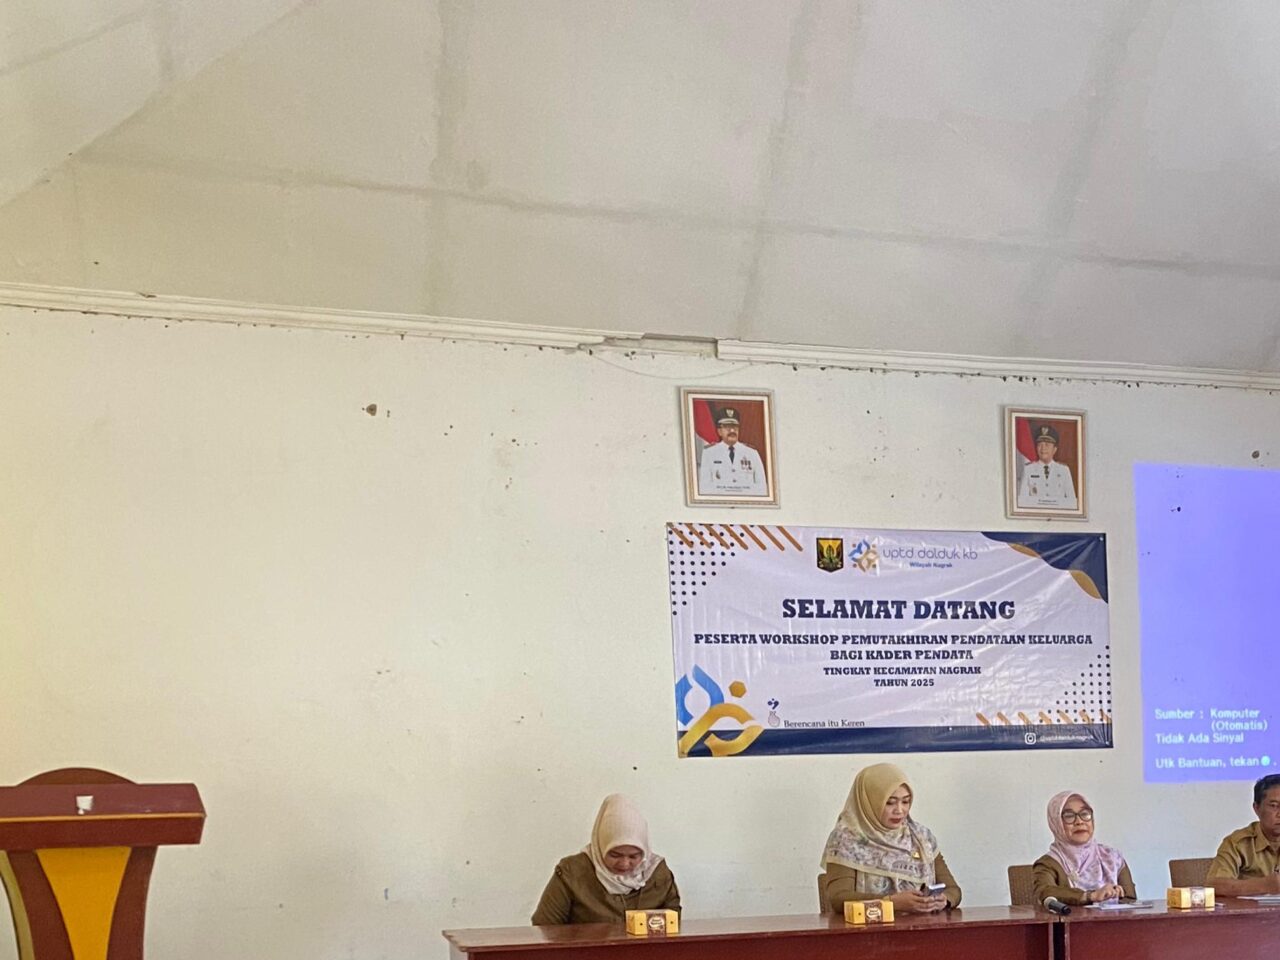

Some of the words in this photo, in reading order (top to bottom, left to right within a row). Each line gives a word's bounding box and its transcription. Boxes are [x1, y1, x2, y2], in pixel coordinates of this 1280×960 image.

[883, 547, 914, 559] uptd
[963, 550, 978, 560] kb
[782, 599, 907, 619] SELAMAT
[913, 600, 1015, 620] DATANG
[694, 633, 758, 644] PESERTA
[759, 634, 839, 645] WORKSHOP
[842, 634, 948, 645] PEMUTAKHIRAN
[951, 634, 1026, 645] PENDATAAN
[1028, 634, 1093, 645] KELUARGA
[830, 650, 863, 660] BAGI
[865, 650, 912, 660] KADER
[915, 650, 974, 660] PENDATA
[823, 667, 871, 675] TINGKAT
[873, 667, 937, 675] KECAMATAN
[939, 666, 981, 675] NAGRAK
[874, 679, 908, 687] TAHUN
[911, 678, 935, 687] 2025
[1154, 708, 1195, 719] Sumber
[1210, 708, 1260, 721] Komputer
[784, 720, 825, 728] Berencana
[841, 719, 865, 727] Keren
[1211, 719, 1268, 731] (Otomatis)
[1155, 732, 1185, 744] Tidak
[1188, 733, 1210, 743] Ada
[1212, 732, 1244, 744] Sinyal
[1155, 758, 1175, 768] Utk
[1178, 757, 1226, 768] Bantuan,
[1230, 756, 1260, 766] tekan
